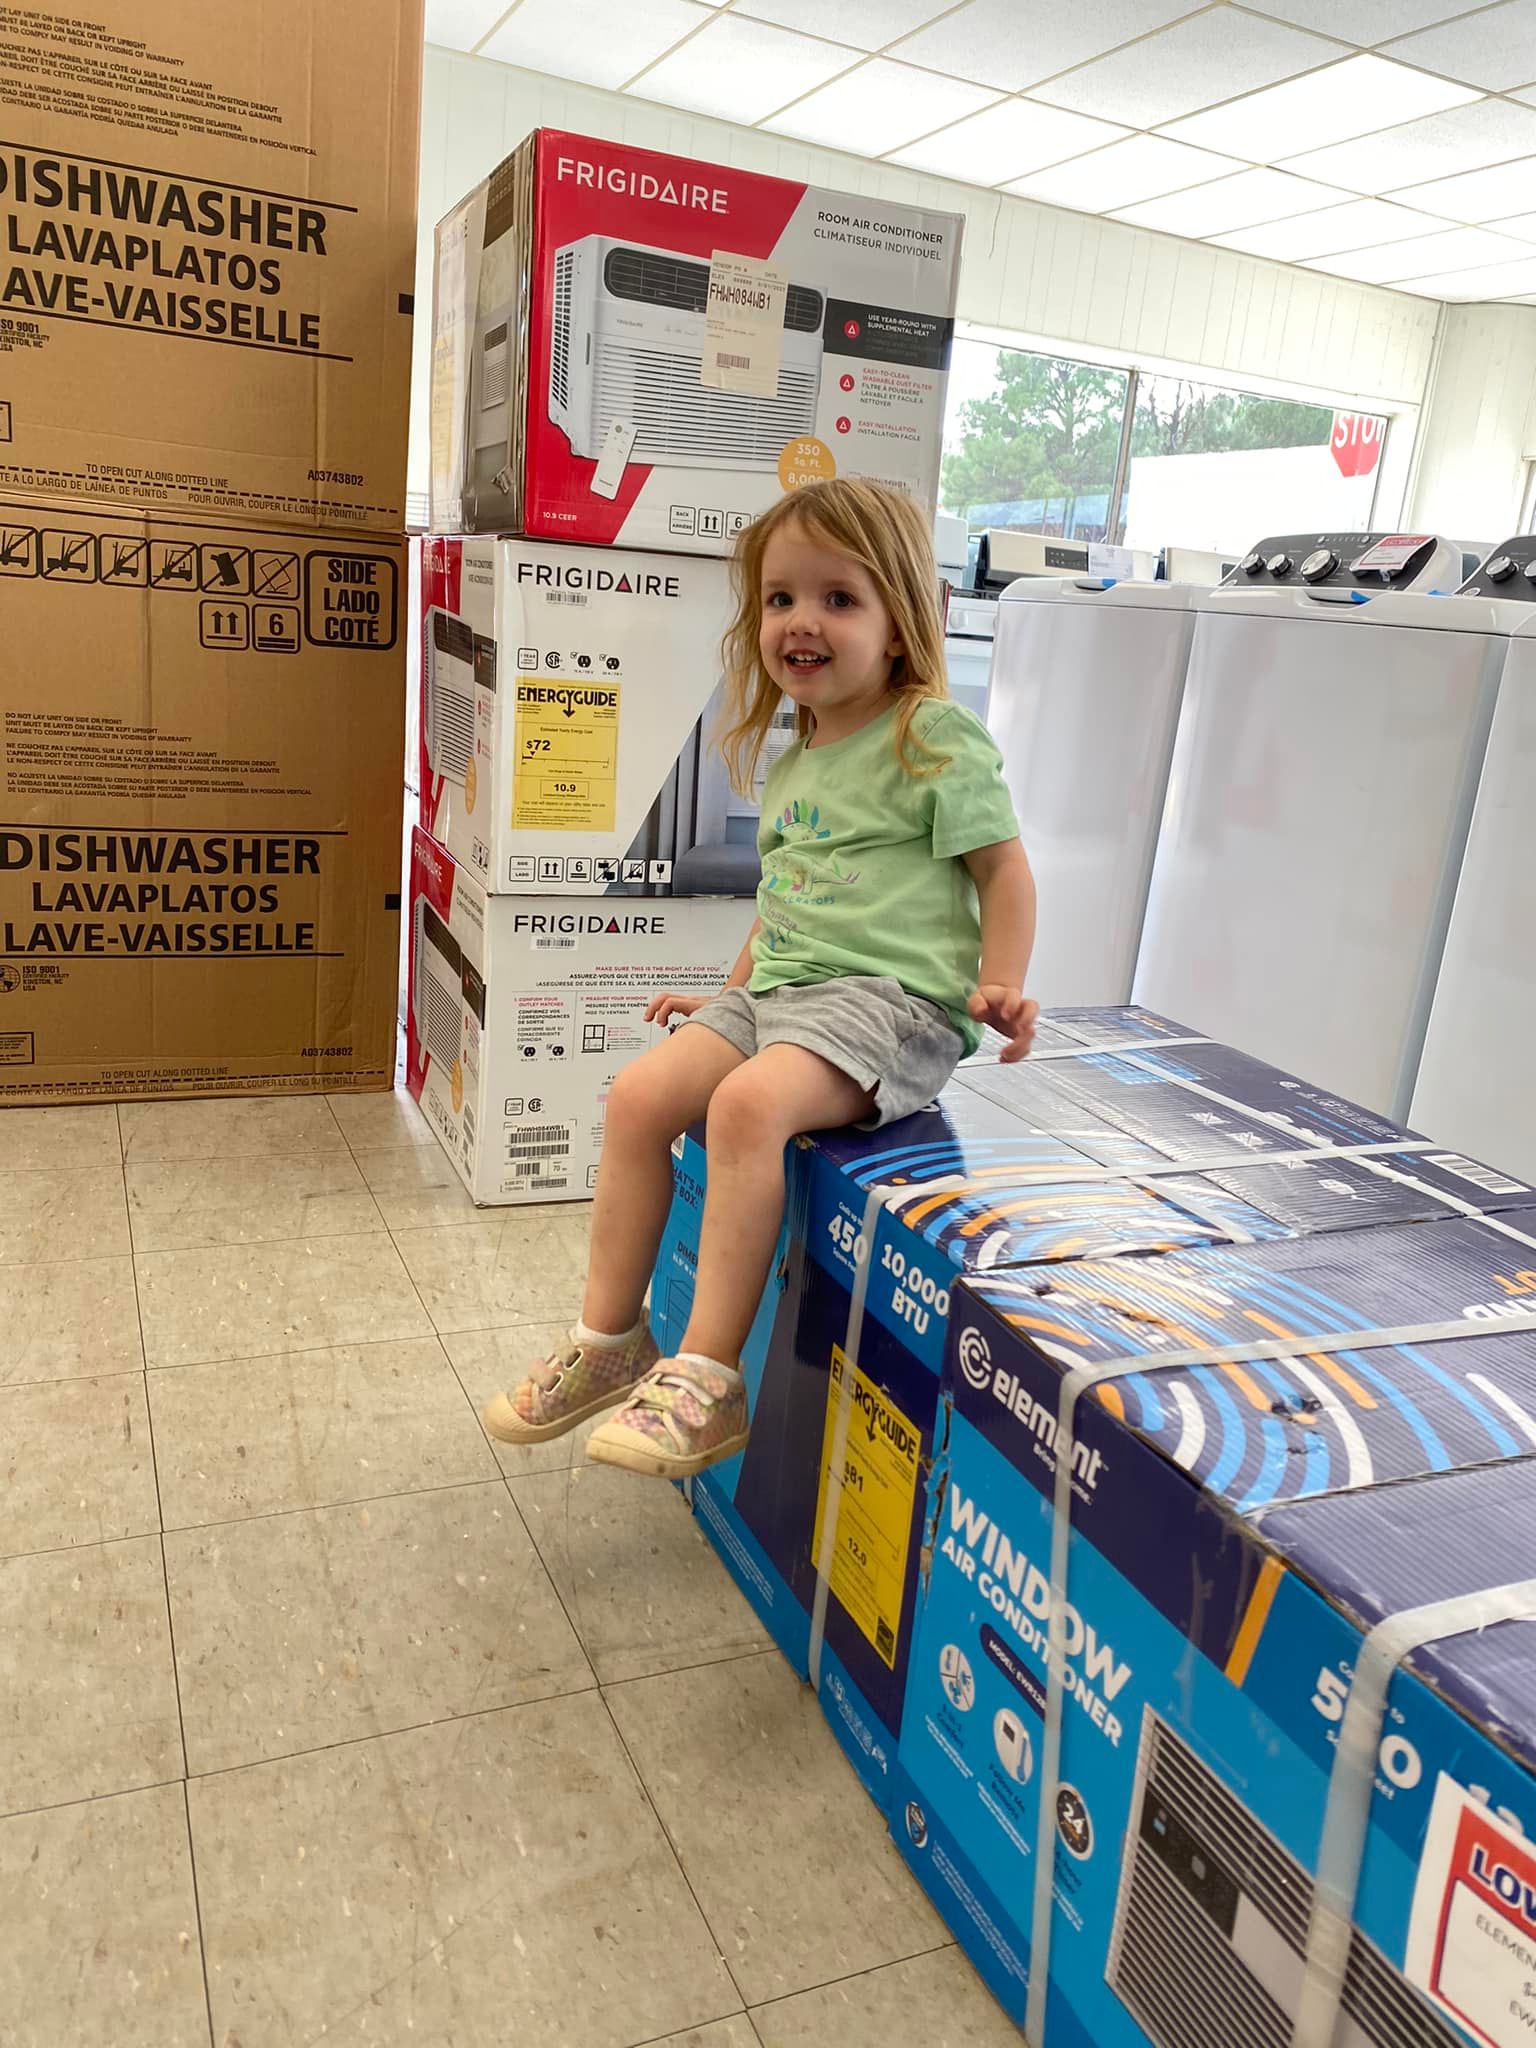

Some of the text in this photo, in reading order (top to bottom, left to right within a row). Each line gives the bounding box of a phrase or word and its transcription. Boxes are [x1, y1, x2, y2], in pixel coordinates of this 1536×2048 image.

[72, 20, 81, 28] OR
[83, 22, 106, 33] FRONT
[10, 26, 18, 34] TO
[21, 28, 48, 40] COMPLY
[51, 34, 66, 43] MAY
[69, 38, 92, 49] RESULT
[104, 45, 133, 57] VOIDING
[135, 51, 143, 59] OF
[146, 53, 184, 67] WARRANTY
[557, 157, 730, 214] FRIGIDAIRE
[0, 155, 327, 256] ISHWASHER
[818, 211, 943, 244] ROOM AIR CONDITIONER
[7, 215, 281, 296] LAVAPLATOS
[814, 228, 942, 260] CLIMATISEUR INDIVIDUEL
[2, 267, 320, 350] AVE-VAISSELLE
[710, 283, 771, 310] FHWH084WB1
[16, 321, 39, 333] 9001
[868, 322, 930, 337] SUPPLEMENTAL HEAT
[882, 316, 920, 328] YEAR-ROUND
[920, 322, 936, 331] WITH
[862, 375, 932, 390] WASHABLE DUST FILTER
[862, 382, 881, 391] FILTRE
[863, 368, 910, 380] EASY-TO-CLEAN
[860, 398, 892, 407] NETTOYER
[861, 390, 888, 400] LAVABLE
[898, 395, 917, 404] FACILE
[858, 420, 916, 433] EASY INSTALLATION
[858, 428, 920, 442] INSTALLATION FACILE
[1334, 412, 1380, 448] STO
[794, 457, 822, 468] Sq. Ft.
[796, 443, 820, 456] 350
[13, 474, 19, 483] A
[22, 475, 33, 485] LO
[37, 476, 67, 489] LARGO
[70, 480, 82, 490] DE
[119, 485, 130, 495] DE
[133, 488, 168, 499] PUNTOS
[86, 463, 228, 488] TO OPEN CUT ALONG DOTTED LINE
[308, 470, 364, 486] A03743802
[188, 493, 211, 504] POUR
[214, 496, 246, 509] OUVRIR,
[248, 500, 280, 511] COUPER
[283, 503, 292, 513] LE
[295, 505, 316, 516] LONG
[329, 508, 368, 521] POINTILLÉ
[735, 517, 742, 529] 6
[328, 558, 376, 586] SIDE
[518, 563, 680, 598] FRIGIDAIRE
[324, 587, 380, 614] LADO
[269, 613, 284, 636] 6
[324, 613, 379, 643] COTÉ
[518, 687, 617, 707] ENERGYGUIDE
[526, 739, 551, 751] $72
[554, 784, 576, 792] 10.9
[0, 833, 320, 874] DISHWASHER
[576, 861, 583, 872] 6
[32, 882, 278, 914] LAVAPLATOS
[4, 922, 314, 952] LAVE-VAISSELLE
[514, 915, 666, 934] FRIGIDAIRE
[22, 966, 60, 974] ISO 9001
[301, 1047, 352, 1057] A03743802
[101, 1066, 230, 1080] TO OPEN CUT ALONG DOTTED LINE
[828, 1214, 868, 1264] 450
[678, 1240, 698, 1267] DIME
[881, 1244, 950, 1316] 10,000
[892, 1286, 930, 1335] BTU
[832, 1358, 916, 1464] ERGYGUIDE
[848, 1537, 866, 1568] 12.0
[952, 1483, 1132, 1701] WINDOW
[942, 1536, 976, 1582] AIR
[978, 1572, 1122, 1748] CONDITONER
[1311, 1666, 1422, 1790] 50
[1064, 1803, 1085, 1834] 24
